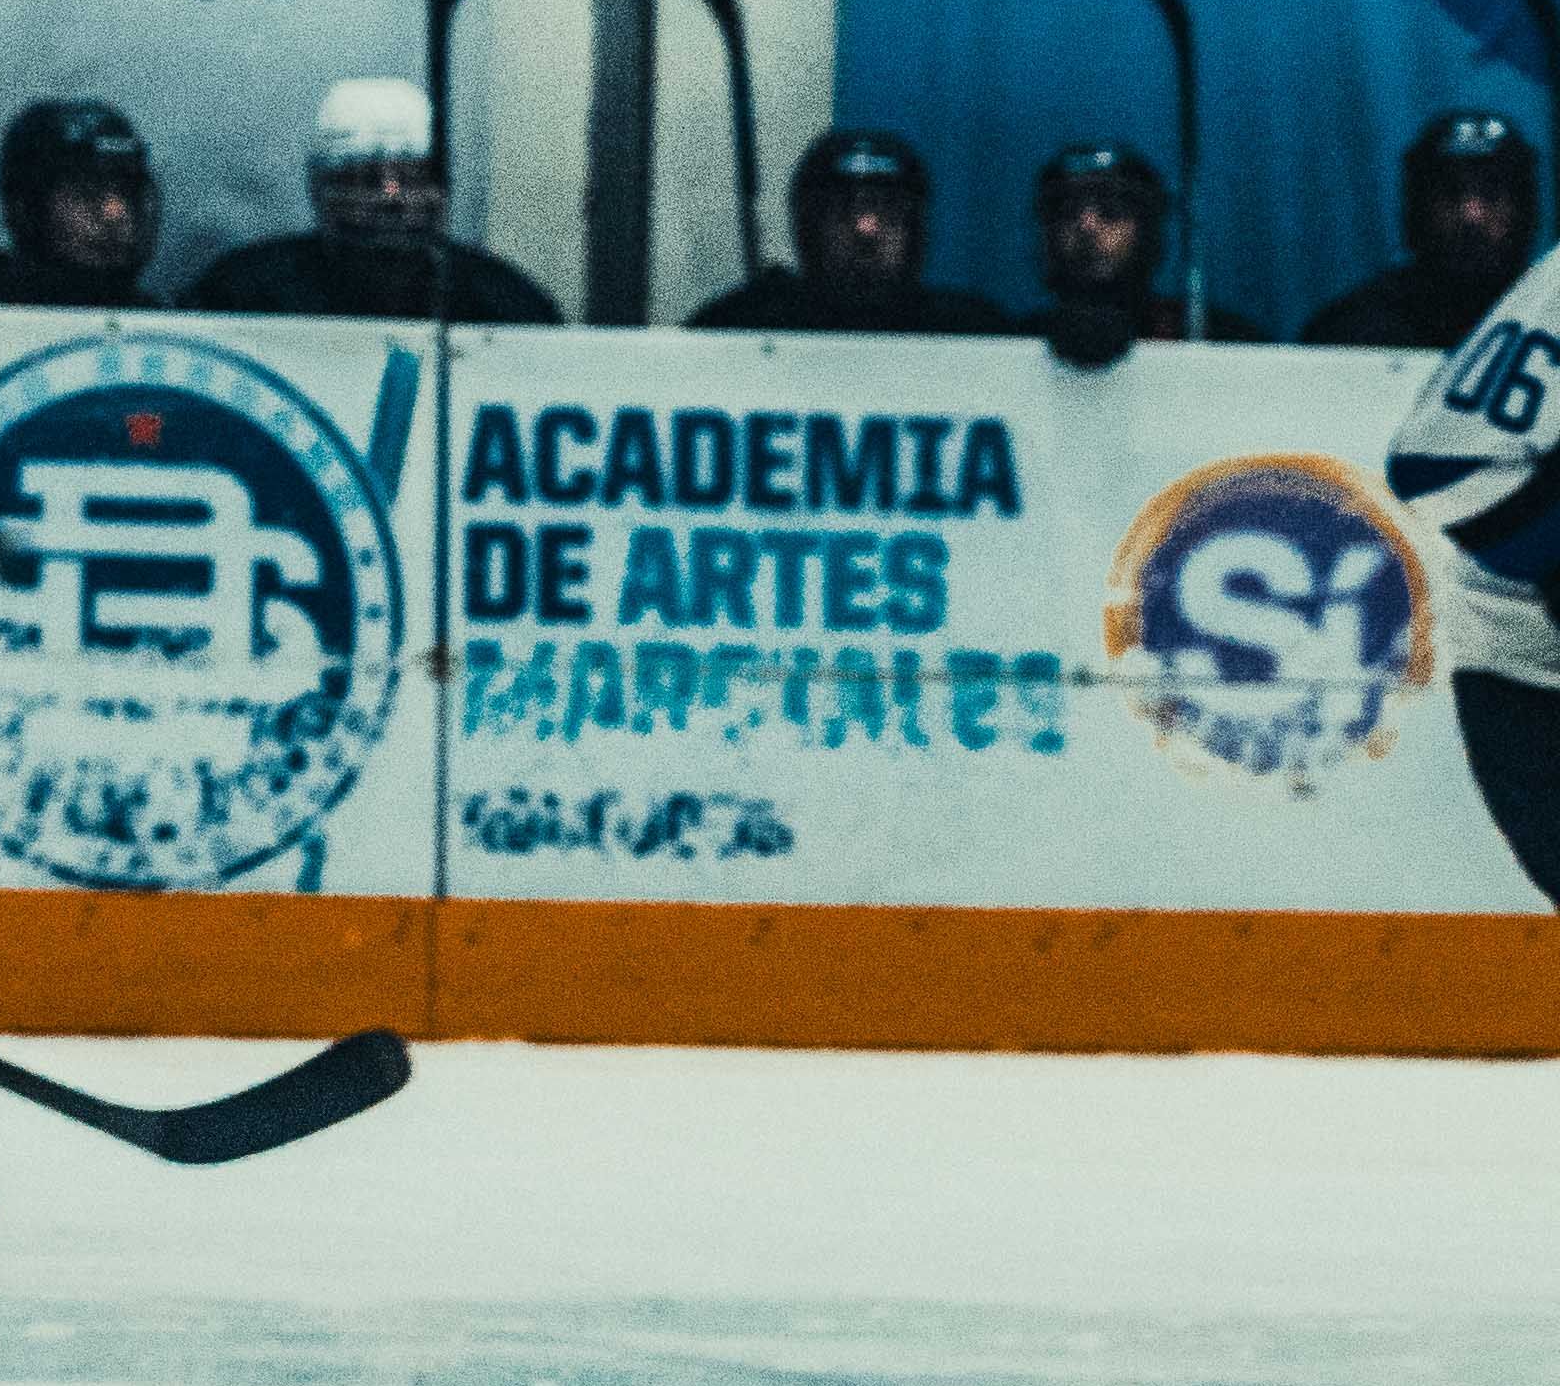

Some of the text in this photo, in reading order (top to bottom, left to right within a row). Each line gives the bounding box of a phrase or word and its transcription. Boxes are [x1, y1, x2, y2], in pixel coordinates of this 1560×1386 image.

[462, 401, 1024, 521] ACADEMIA
[464, 521, 950, 635] DE ARTES
